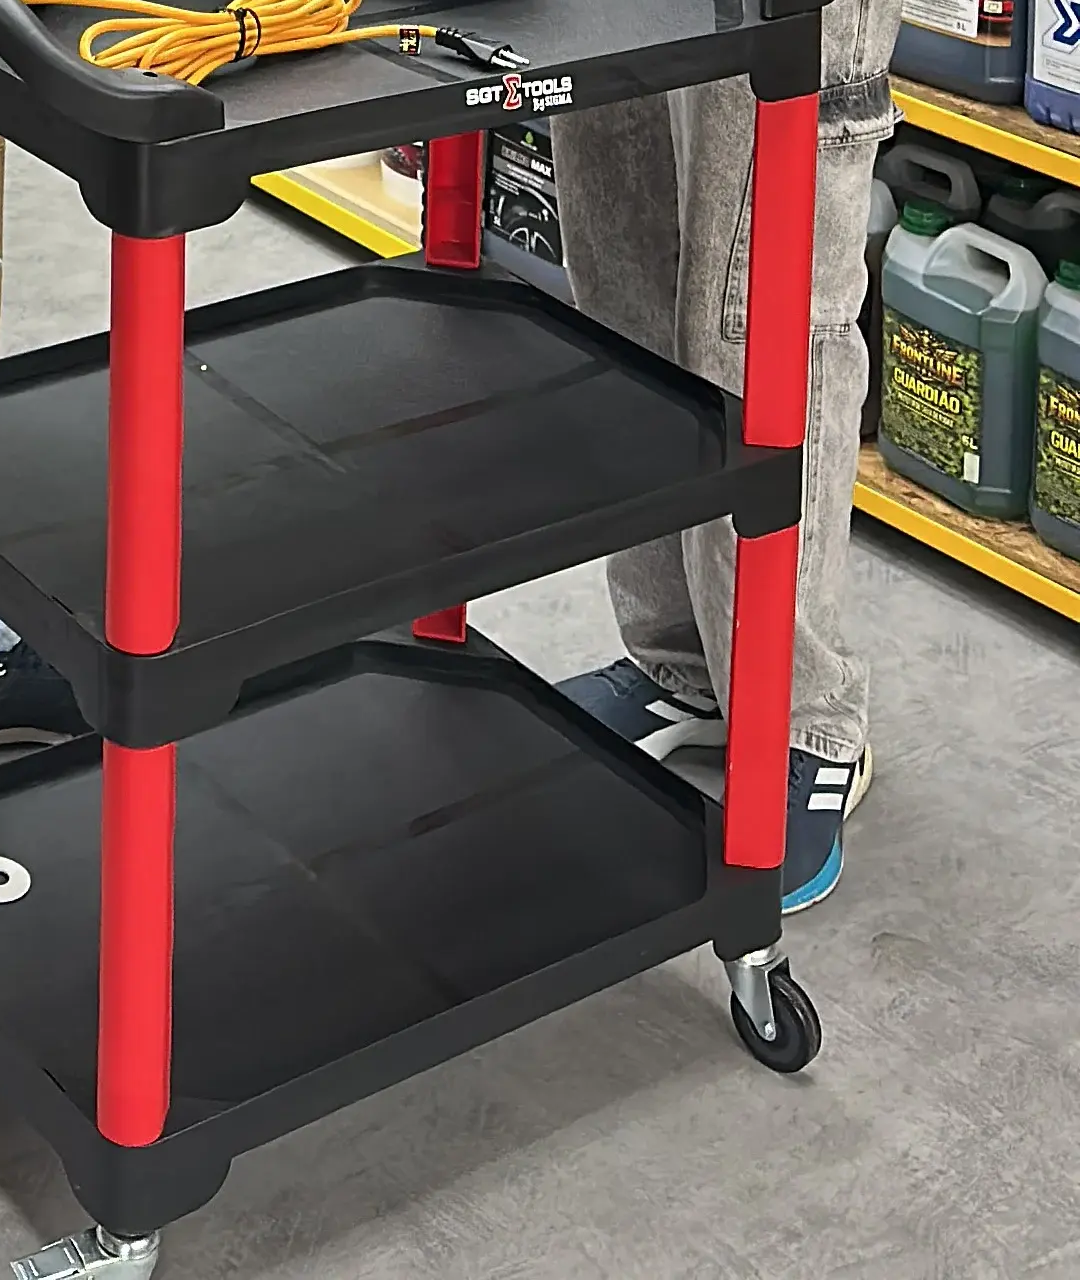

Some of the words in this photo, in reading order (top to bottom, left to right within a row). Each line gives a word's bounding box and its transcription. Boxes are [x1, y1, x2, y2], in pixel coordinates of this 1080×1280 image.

[466, 85, 504, 105] SGT
[521, 76, 573, 97] TOOLS
[545, 92, 573, 107] SIGMA
[530, 159, 552, 177] MAX
[892, 333, 965, 386] FRONTLINE
